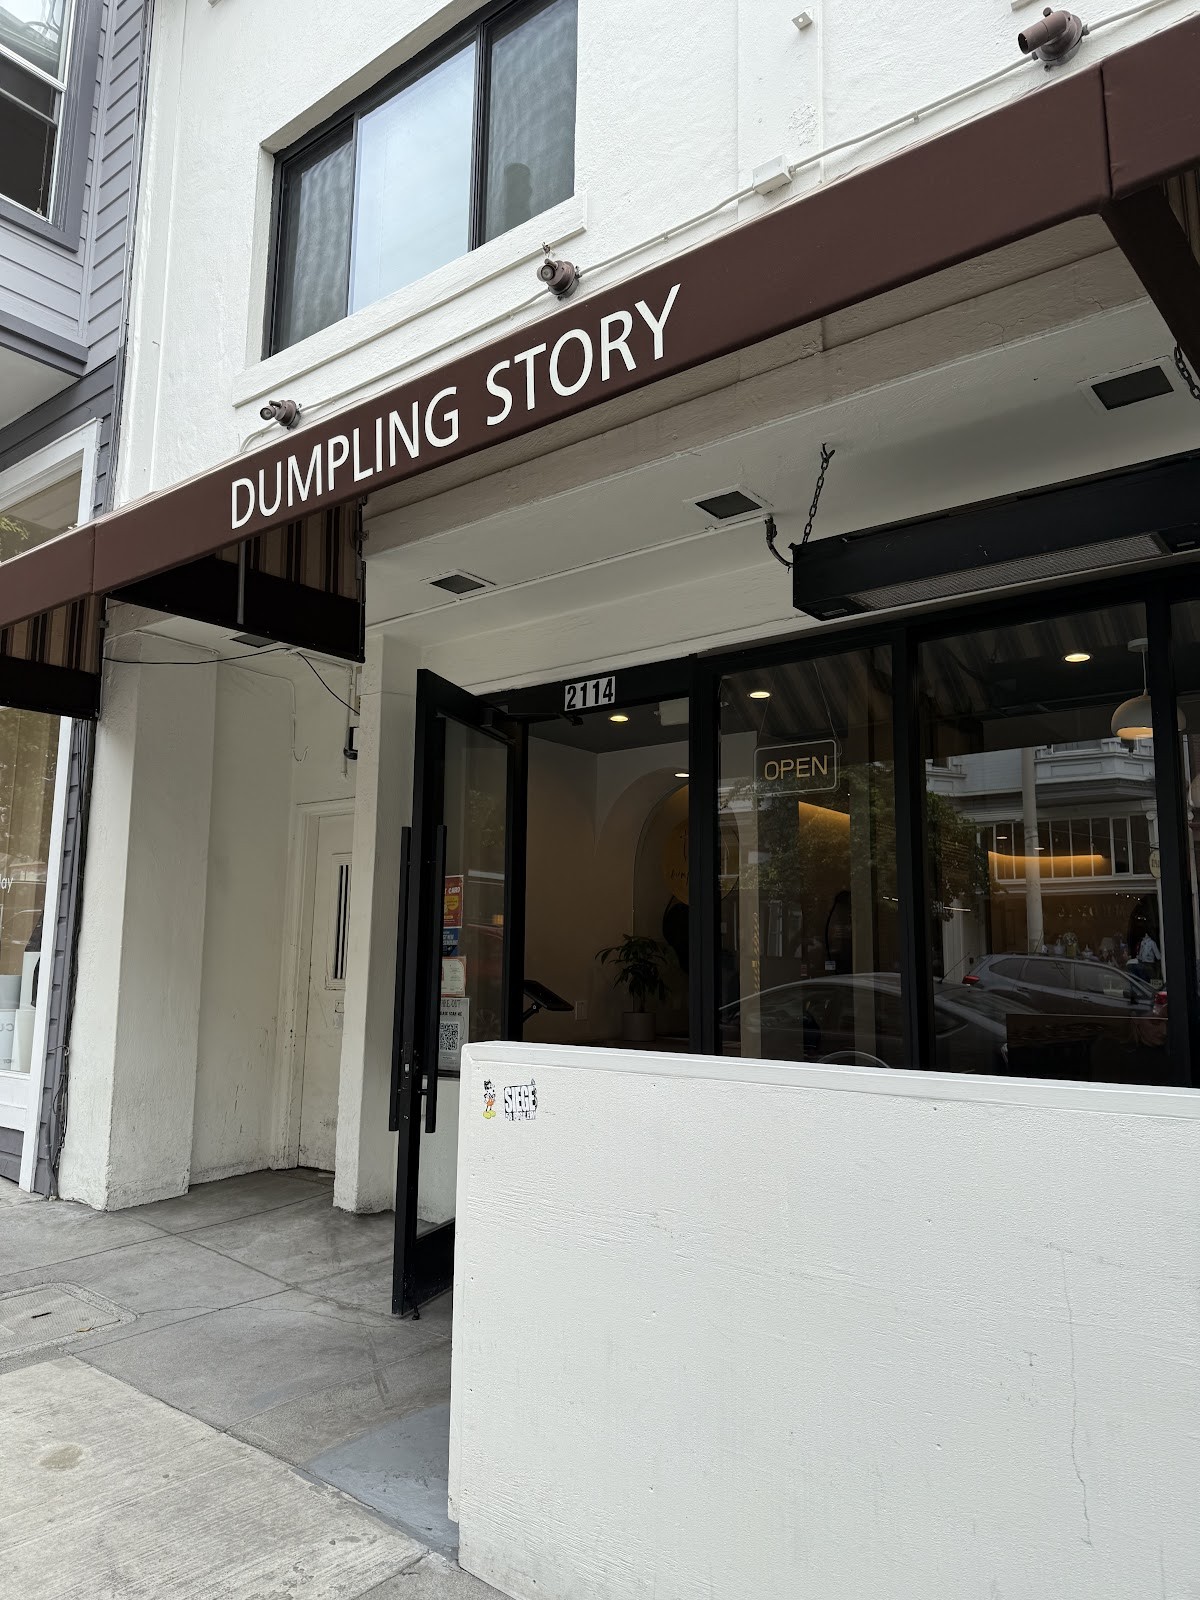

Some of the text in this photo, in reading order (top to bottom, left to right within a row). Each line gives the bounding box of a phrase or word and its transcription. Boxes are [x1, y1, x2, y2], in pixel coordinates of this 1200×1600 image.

[231, 284, 681, 530] DUMPLING STORY
[566, 678, 614, 709] 2114
[764, 755, 828, 781] OPEN
[504, 1085, 535, 1113] SIEGE
